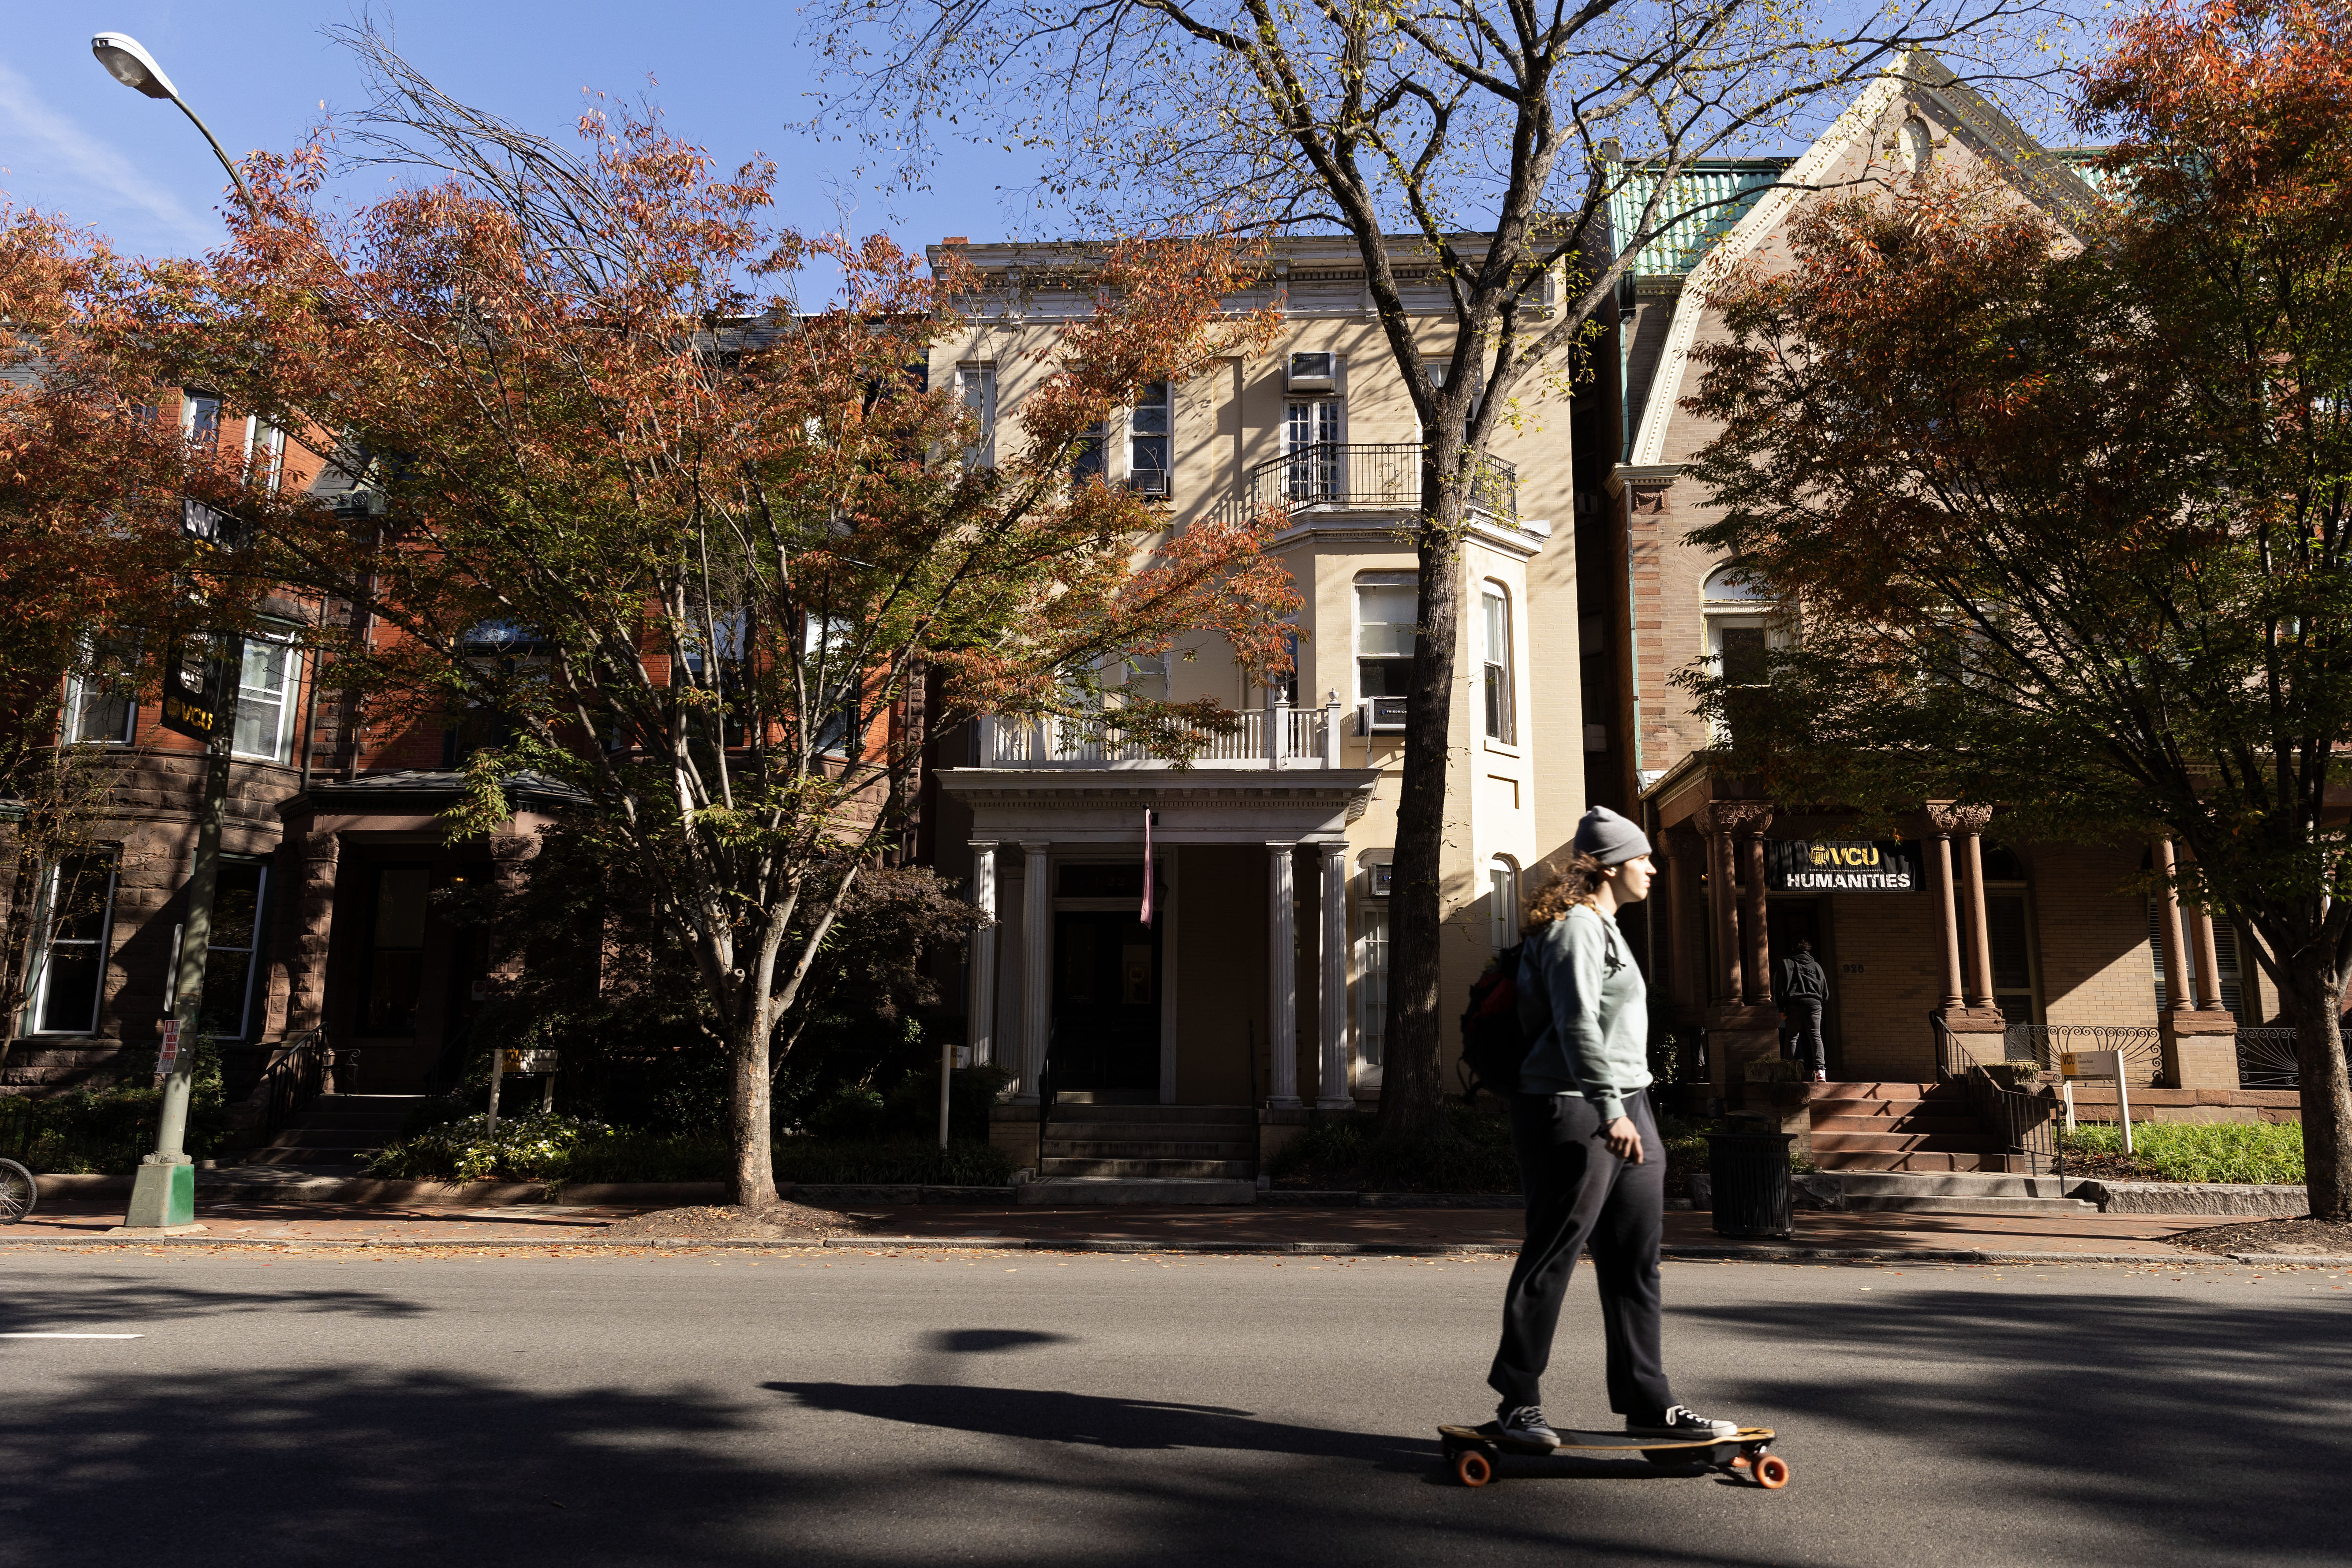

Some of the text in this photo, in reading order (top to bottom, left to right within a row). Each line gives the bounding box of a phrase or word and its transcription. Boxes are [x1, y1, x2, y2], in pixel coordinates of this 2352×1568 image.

[182, 702, 213, 731] VCU
[1829, 847, 1880, 865] VCU
[1787, 873, 1911, 888] HUMANITIES
[2062, 1054, 2075, 1065] VCU
